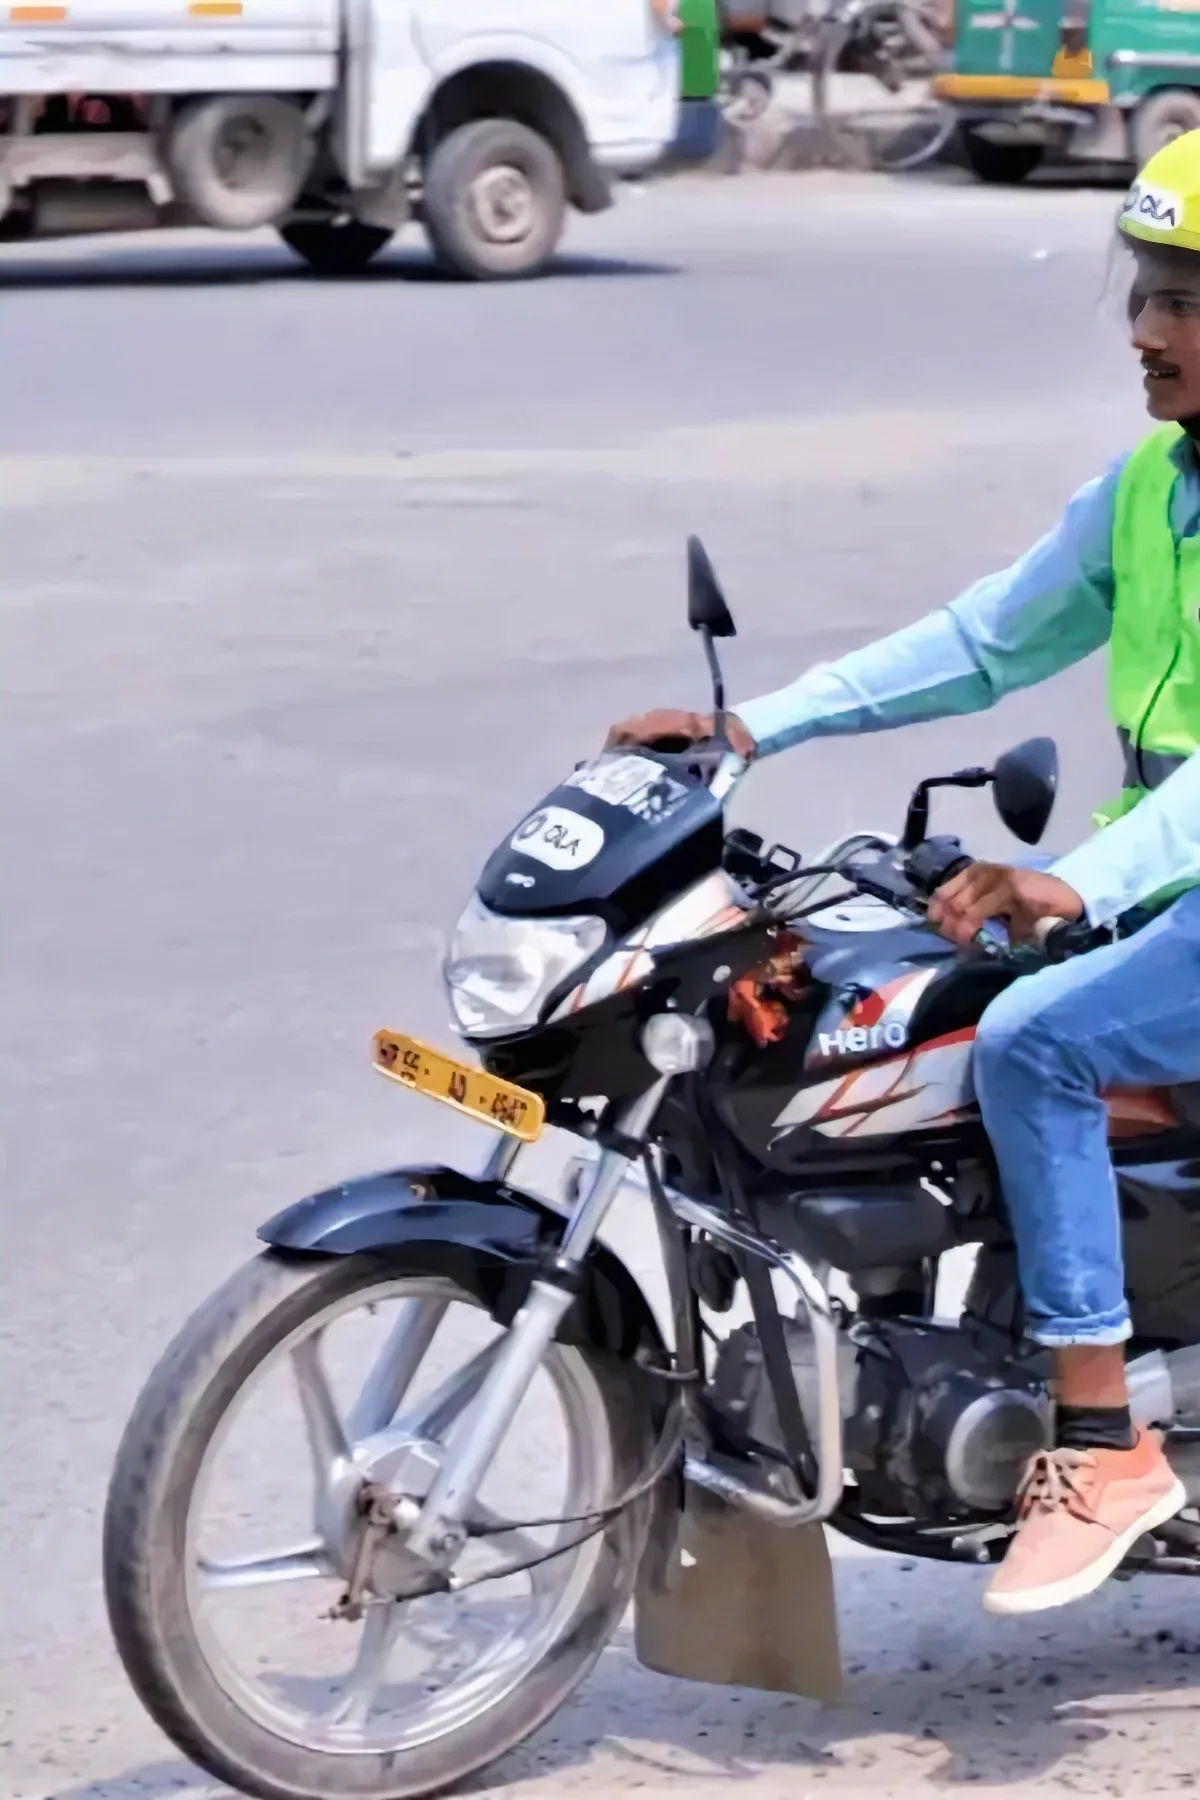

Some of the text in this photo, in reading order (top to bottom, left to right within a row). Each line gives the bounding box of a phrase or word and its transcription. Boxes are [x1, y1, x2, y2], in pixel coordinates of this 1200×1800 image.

[1140, 194, 1175, 227] OLA
[544, 824, 580, 856] OLA
[818, 1022, 906, 1056] Hero
